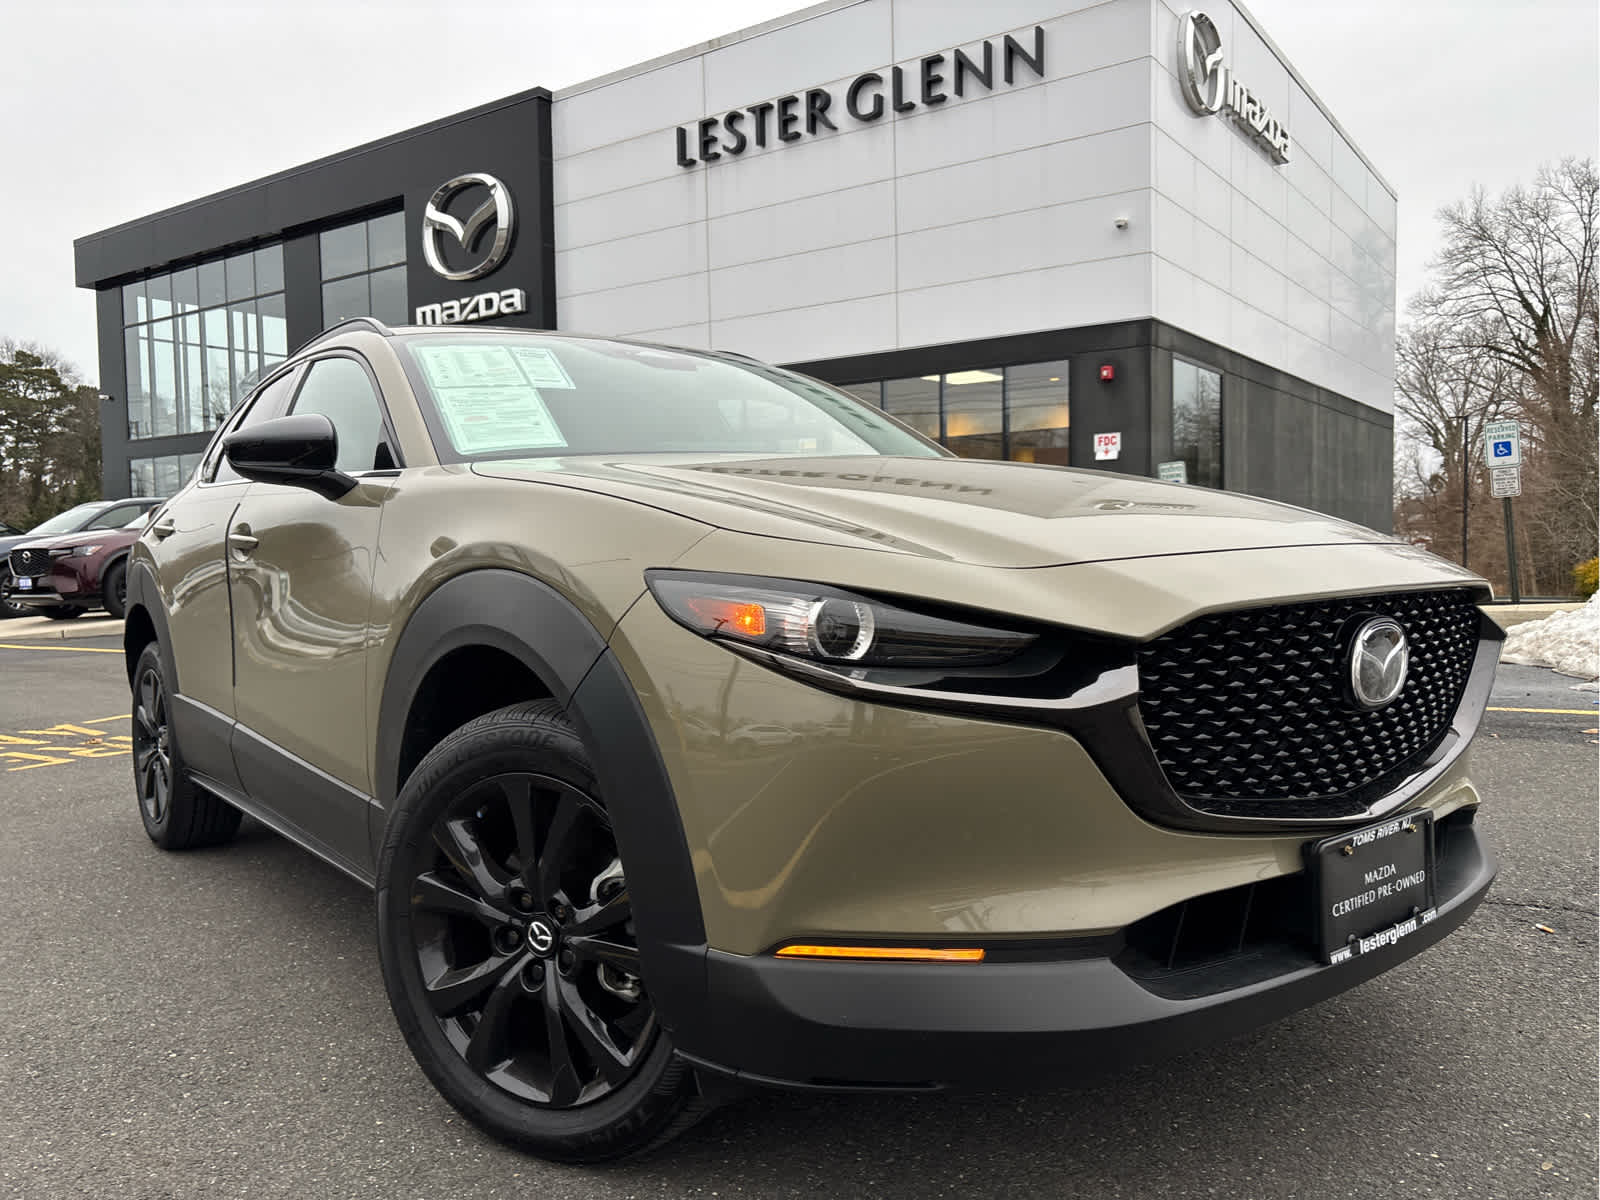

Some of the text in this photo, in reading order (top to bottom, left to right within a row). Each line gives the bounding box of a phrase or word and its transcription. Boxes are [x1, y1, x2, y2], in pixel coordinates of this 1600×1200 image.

[676, 25, 1045, 168] LESTER GLENN
[1223, 66, 1292, 165] mazda
[416, 287, 526, 326] mazda
[1097, 435, 1118, 447] FDC
[1487, 432, 1517, 441] PARKING
[1352, 830, 1376, 847] TOMS
[1364, 863, 1397, 885] MAZDA
[1332, 870, 1425, 917] CERTIFIED PRE-OWNED
[1360, 919, 1417, 955] lesterglenn
